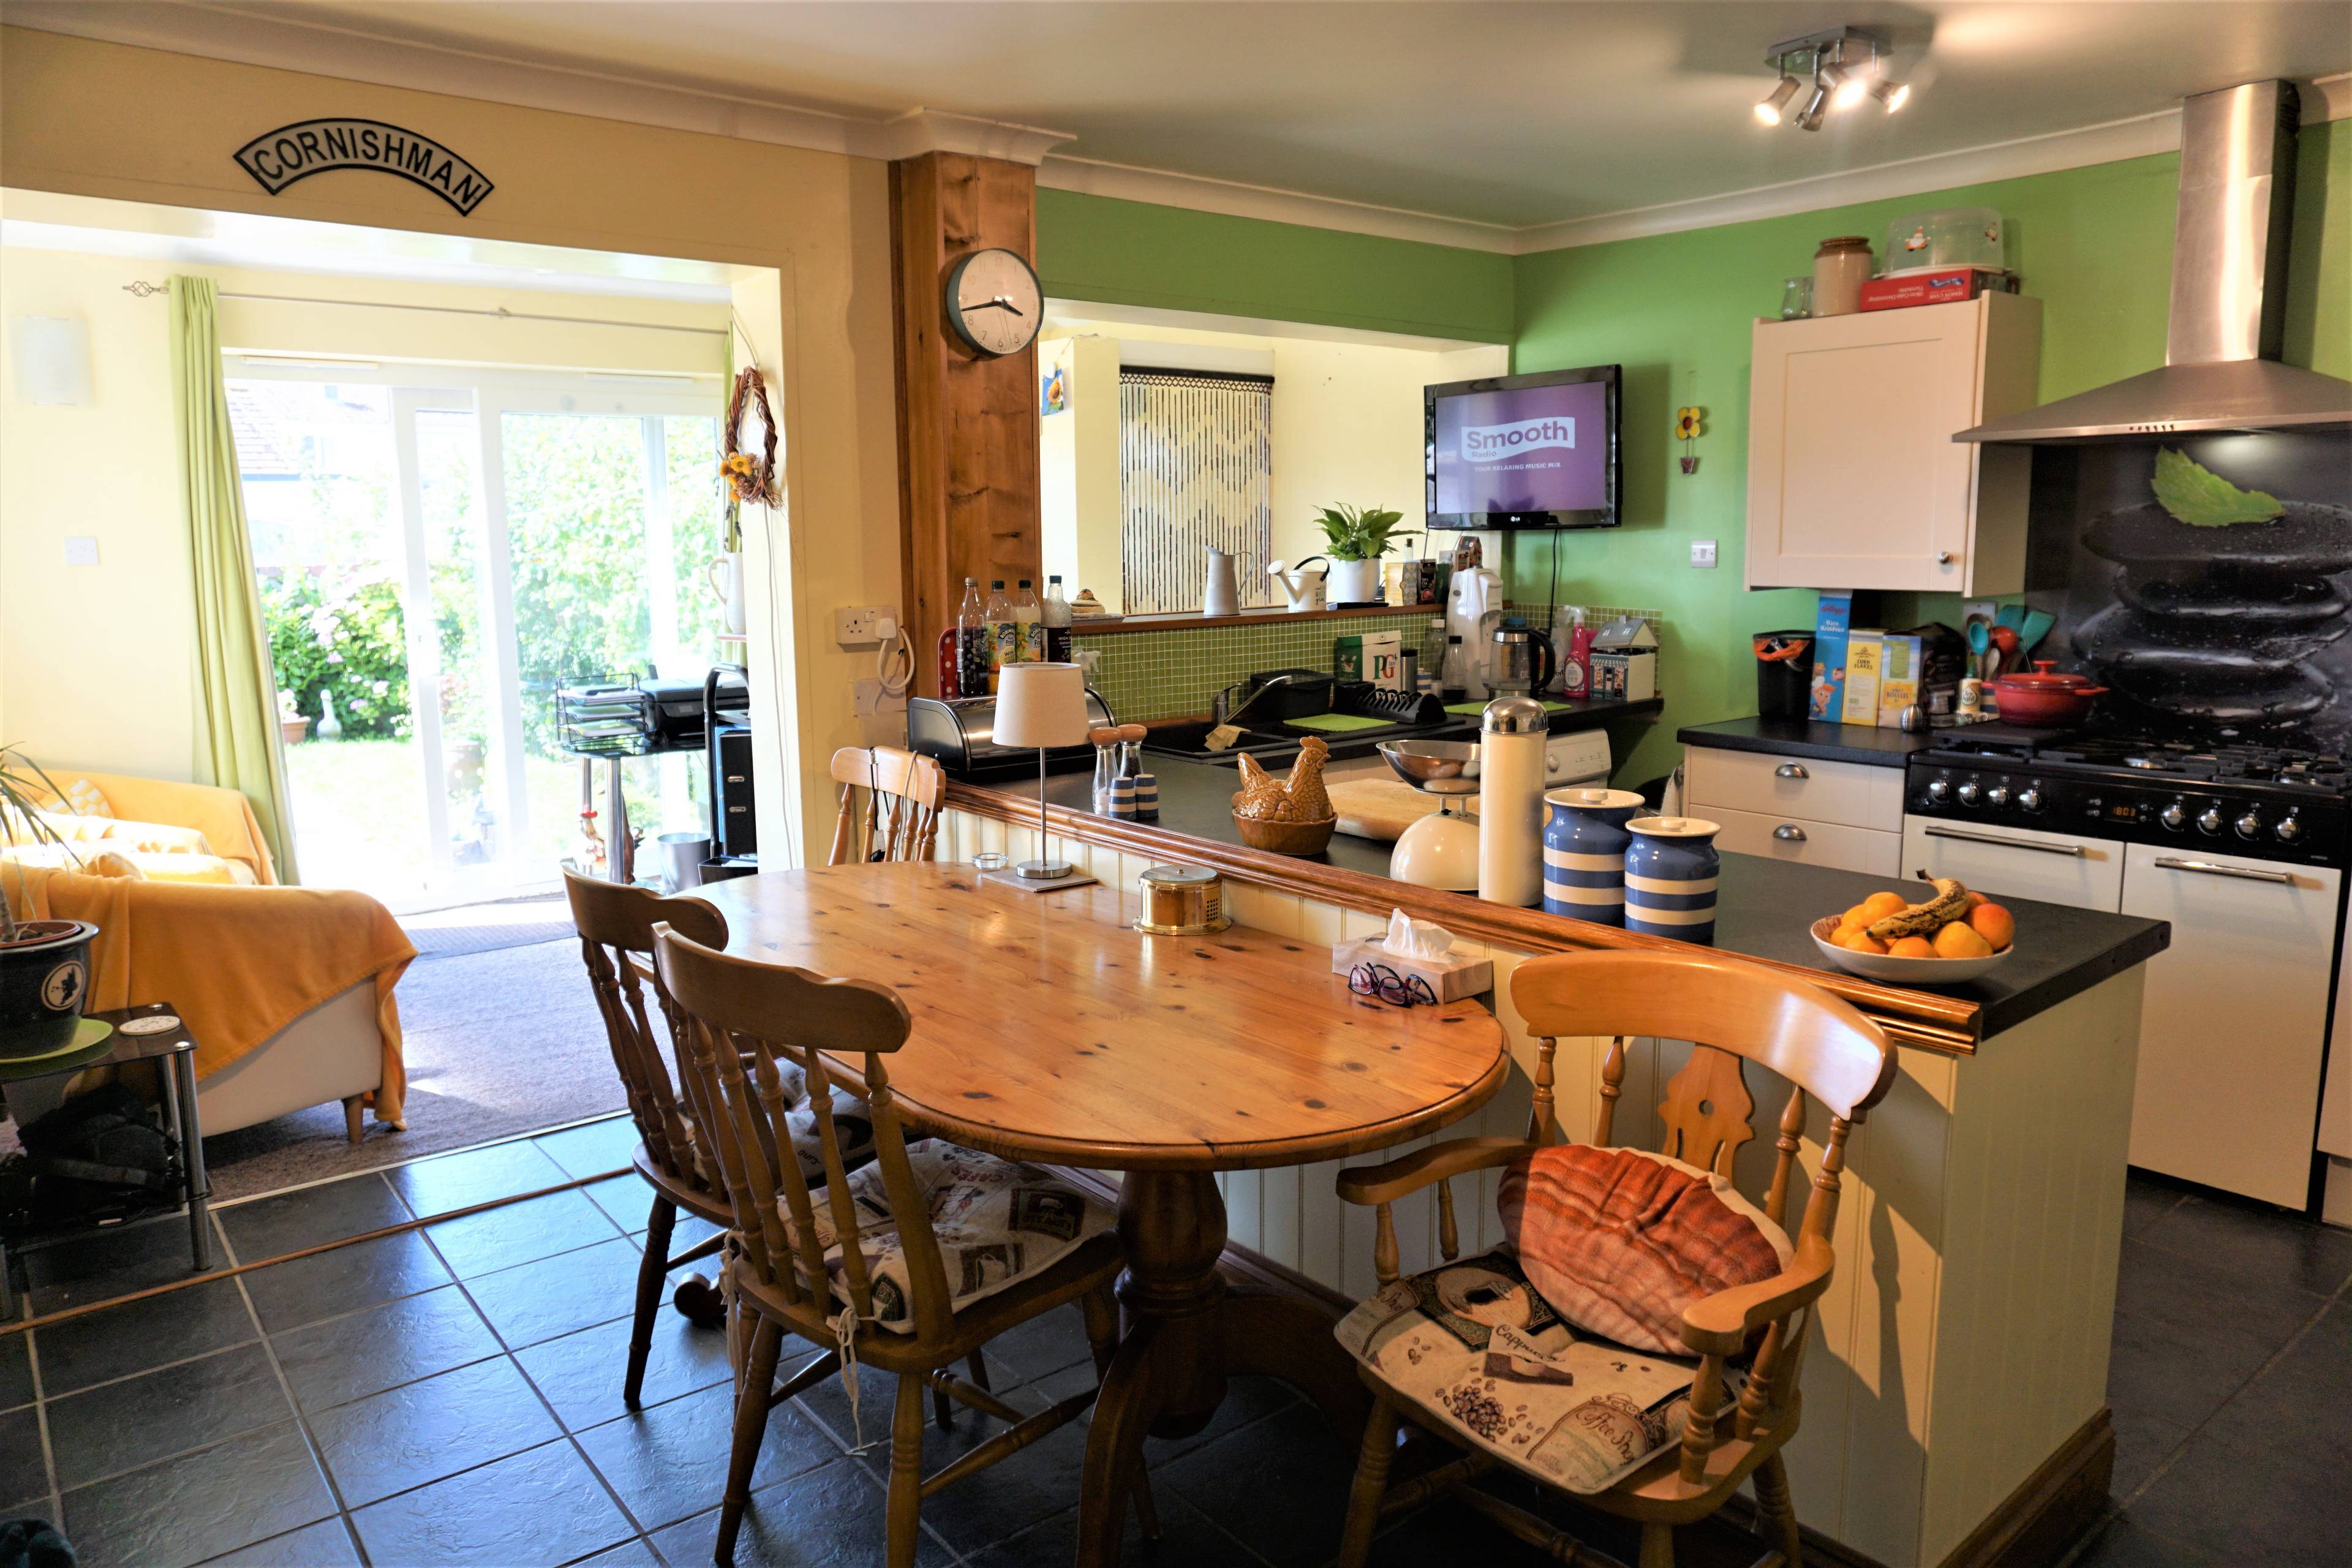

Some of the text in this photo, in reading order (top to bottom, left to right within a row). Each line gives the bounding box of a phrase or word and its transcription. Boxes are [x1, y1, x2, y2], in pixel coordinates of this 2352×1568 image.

[254, 127, 481, 205] CORNISHMAN
[979, 261, 987, 271] 11
[995, 256, 1003, 266] 12
[967, 274, 975, 285] 10
[1025, 280, 1030, 289] 2
[962, 294, 968, 304] 9
[968, 315, 974, 326] 8
[1025, 320, 1031, 330] 4
[982, 330, 988, 341] 7
[1014, 334, 1020, 344] 5
[998, 337, 1004, 348] 6
[1467, 421, 1568, 449] Smooth
[1373, 654, 1395, 679] PG
[1575, 1406, 1616, 1436] Coffee
